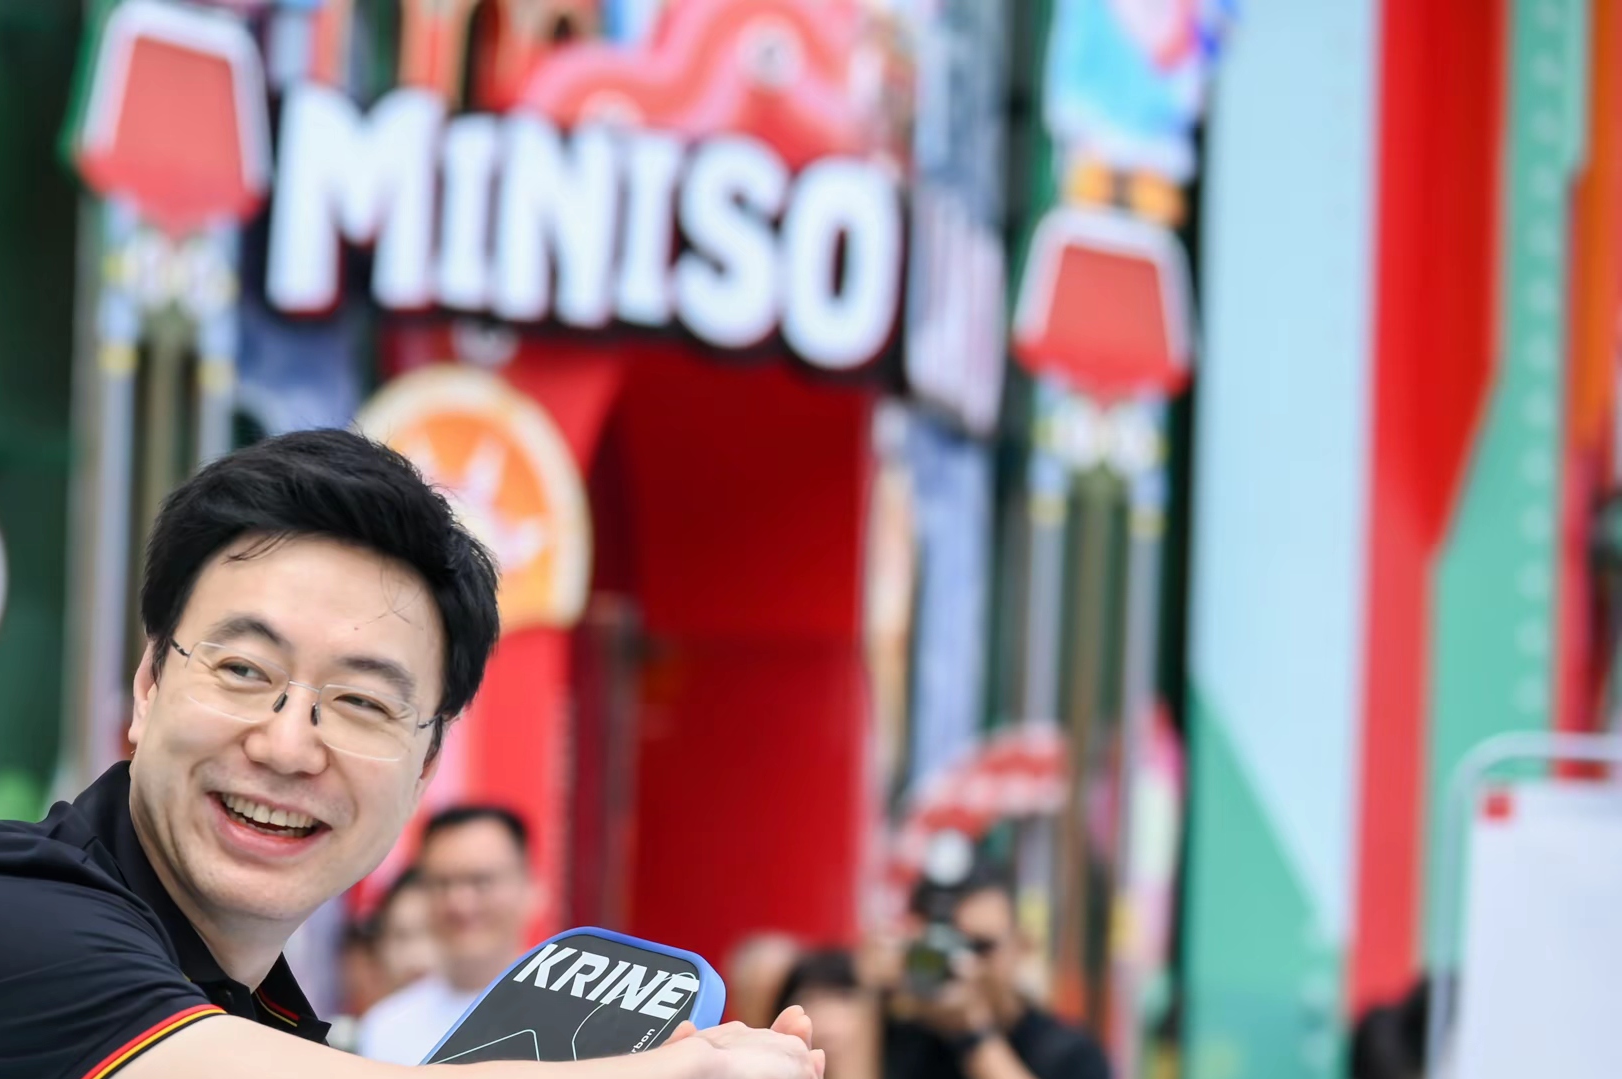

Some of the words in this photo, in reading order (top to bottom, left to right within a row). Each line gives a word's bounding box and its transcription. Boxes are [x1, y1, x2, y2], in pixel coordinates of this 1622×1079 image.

[266, 80, 903, 370] MINISO
[513, 943, 700, 1020] KRINE
[630, 1028, 656, 1054] rbon
